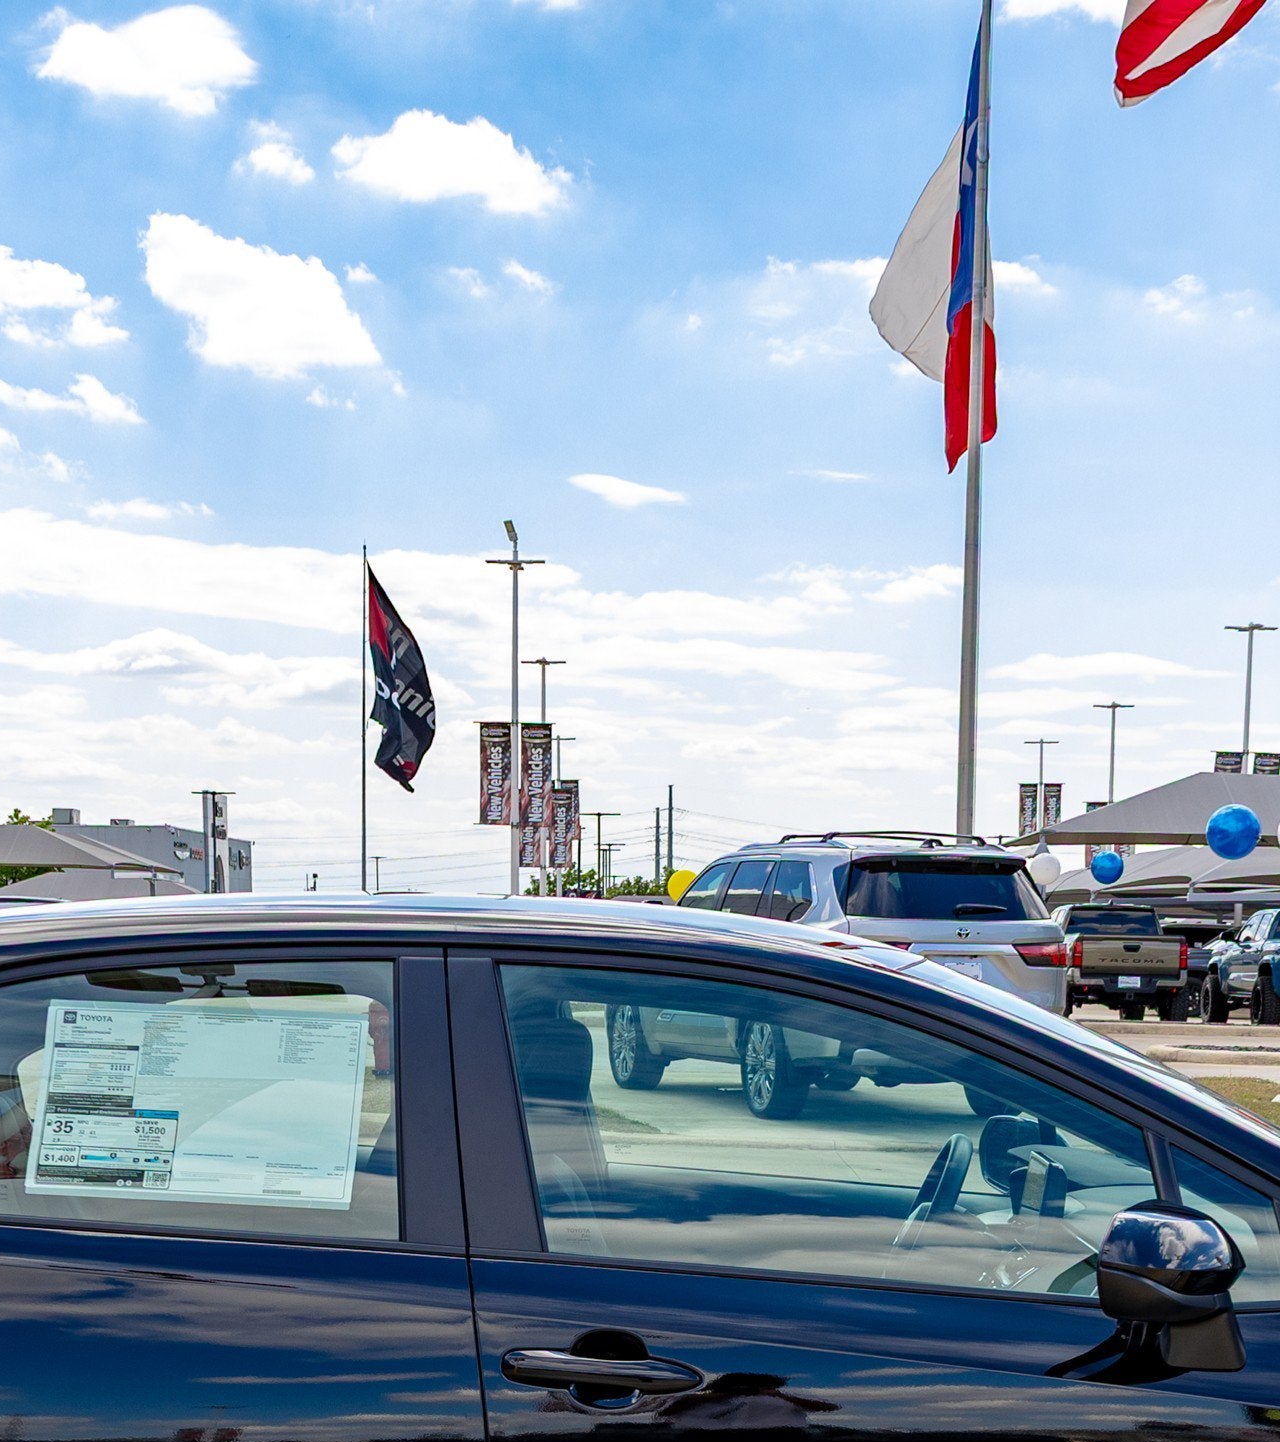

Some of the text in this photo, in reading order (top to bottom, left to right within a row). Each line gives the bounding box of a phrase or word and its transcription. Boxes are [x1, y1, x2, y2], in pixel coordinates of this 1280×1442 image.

[488, 746, 502, 794] Vehicles
[528, 748, 543, 795] Vehicles
[487, 795, 502, 820] New
[528, 796, 543, 822] New
[554, 807, 566, 844] Vehicles
[522, 846, 534, 864] New
[554, 845, 566, 864] New
[80, 1014, 113, 1022] TOYOTA
[52, 1120, 73, 1133] 35
[134, 1125, 166, 1135] $1,500
[43, 1153, 75, 1163] $1,400
